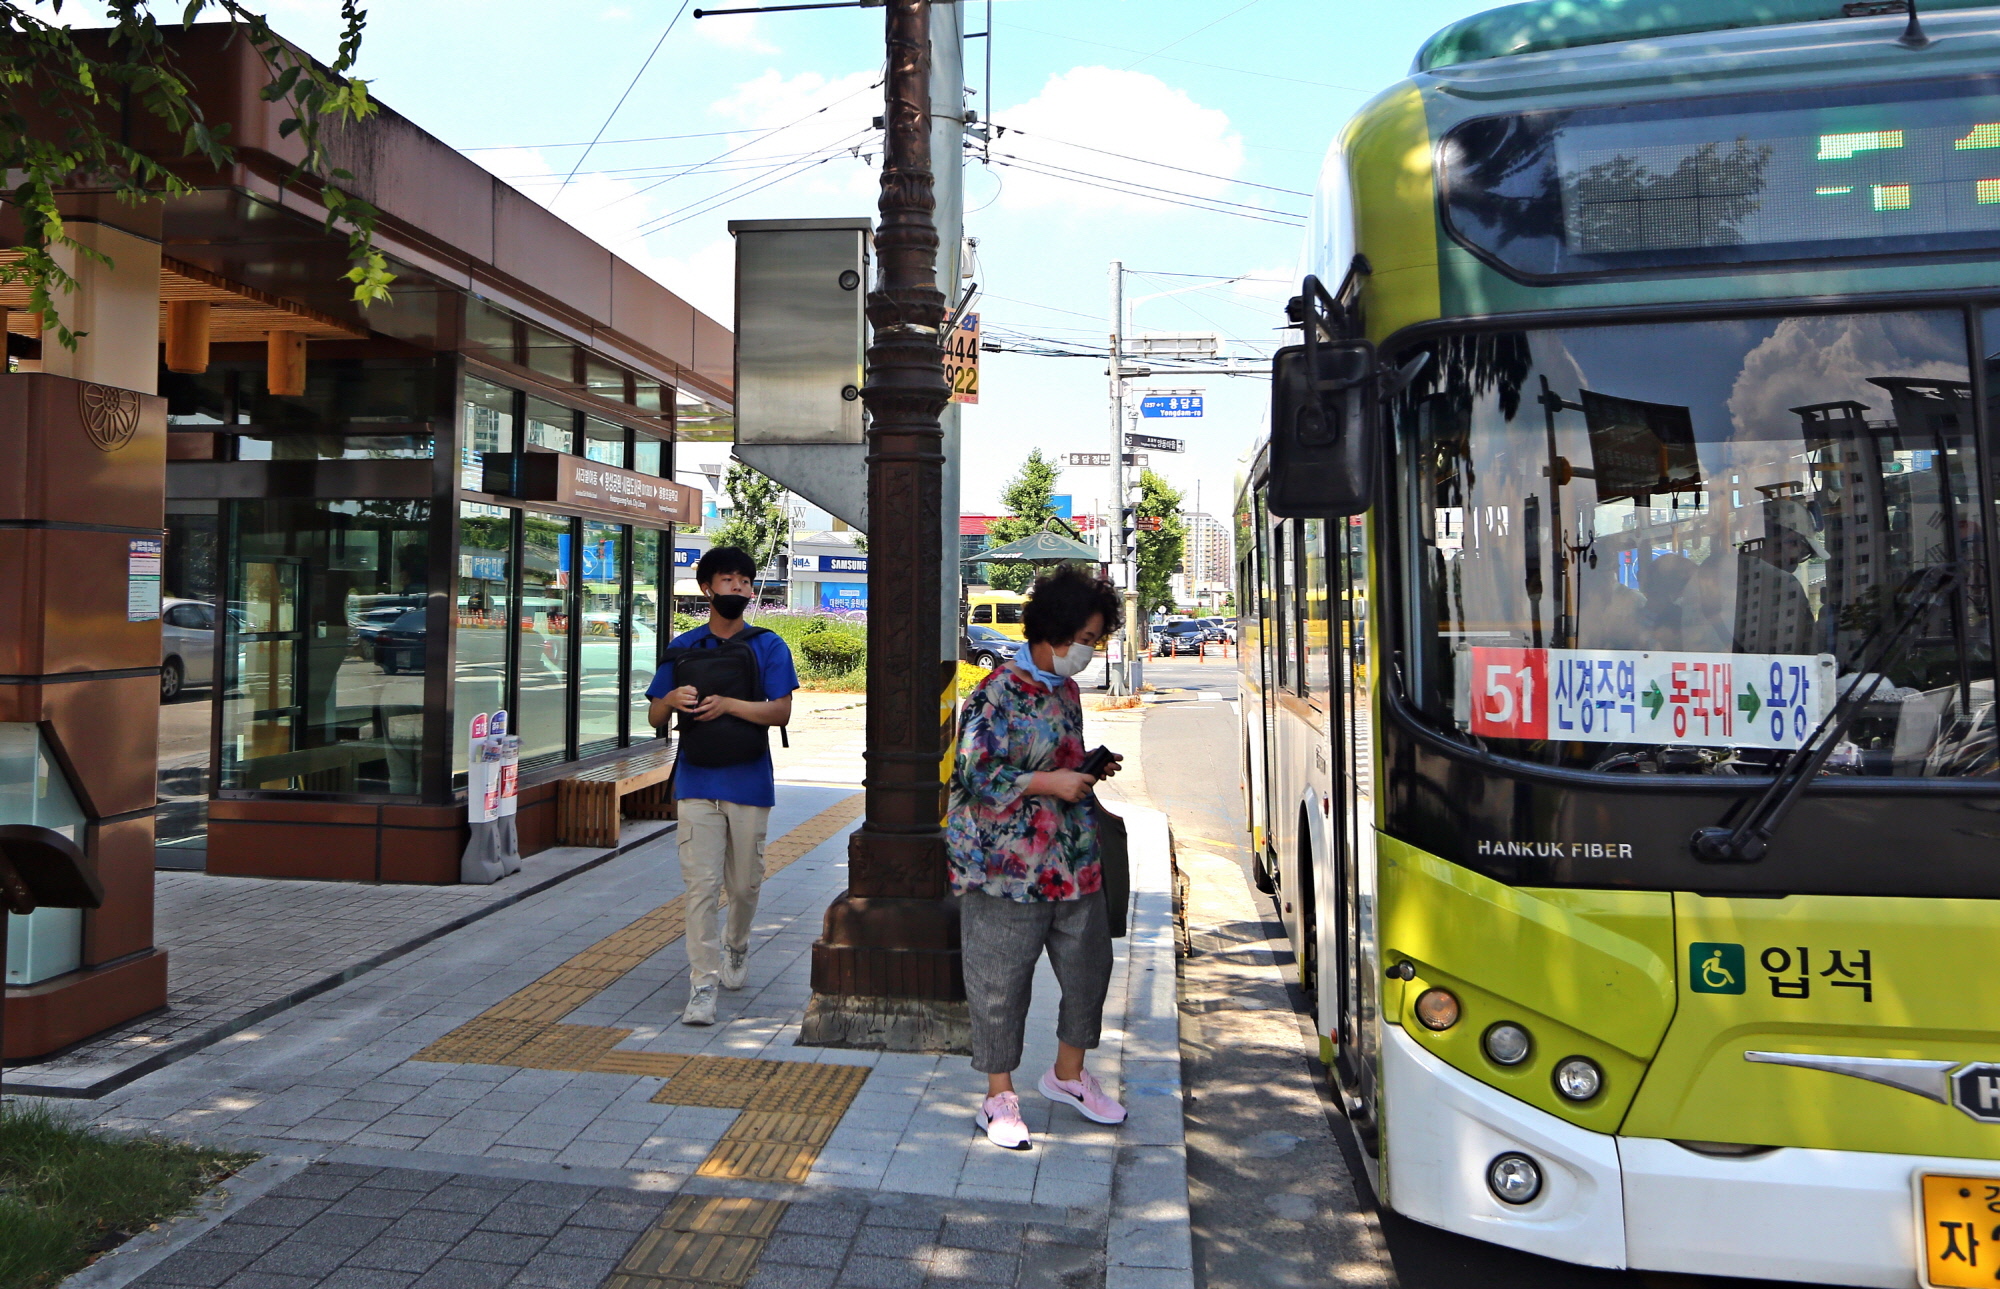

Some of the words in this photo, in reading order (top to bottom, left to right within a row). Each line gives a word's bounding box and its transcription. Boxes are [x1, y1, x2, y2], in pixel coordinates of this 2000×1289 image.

[943, 363, 977, 394] 922
[1168, 398, 1202, 410] 용담로
[1160, 409, 1202, 417] Yongdam-ro
[1071, 454, 1100, 465] 용담정
[793, 506, 807, 518] W
[830, 558, 867, 571] SAMSUNG
[829, 598, 850, 609] 대한민국
[1485, 665, 1534, 723] 51
[1555, 659, 1636, 734] 신경주역
[1669, 661, 1732, 738] 동국대
[1766, 661, 1810, 742] 용강
[1477, 840, 1565, 858] HANKUK
[1571, 842, 1633, 859] FIBER
[1760, 946, 1873, 1003] 입석
